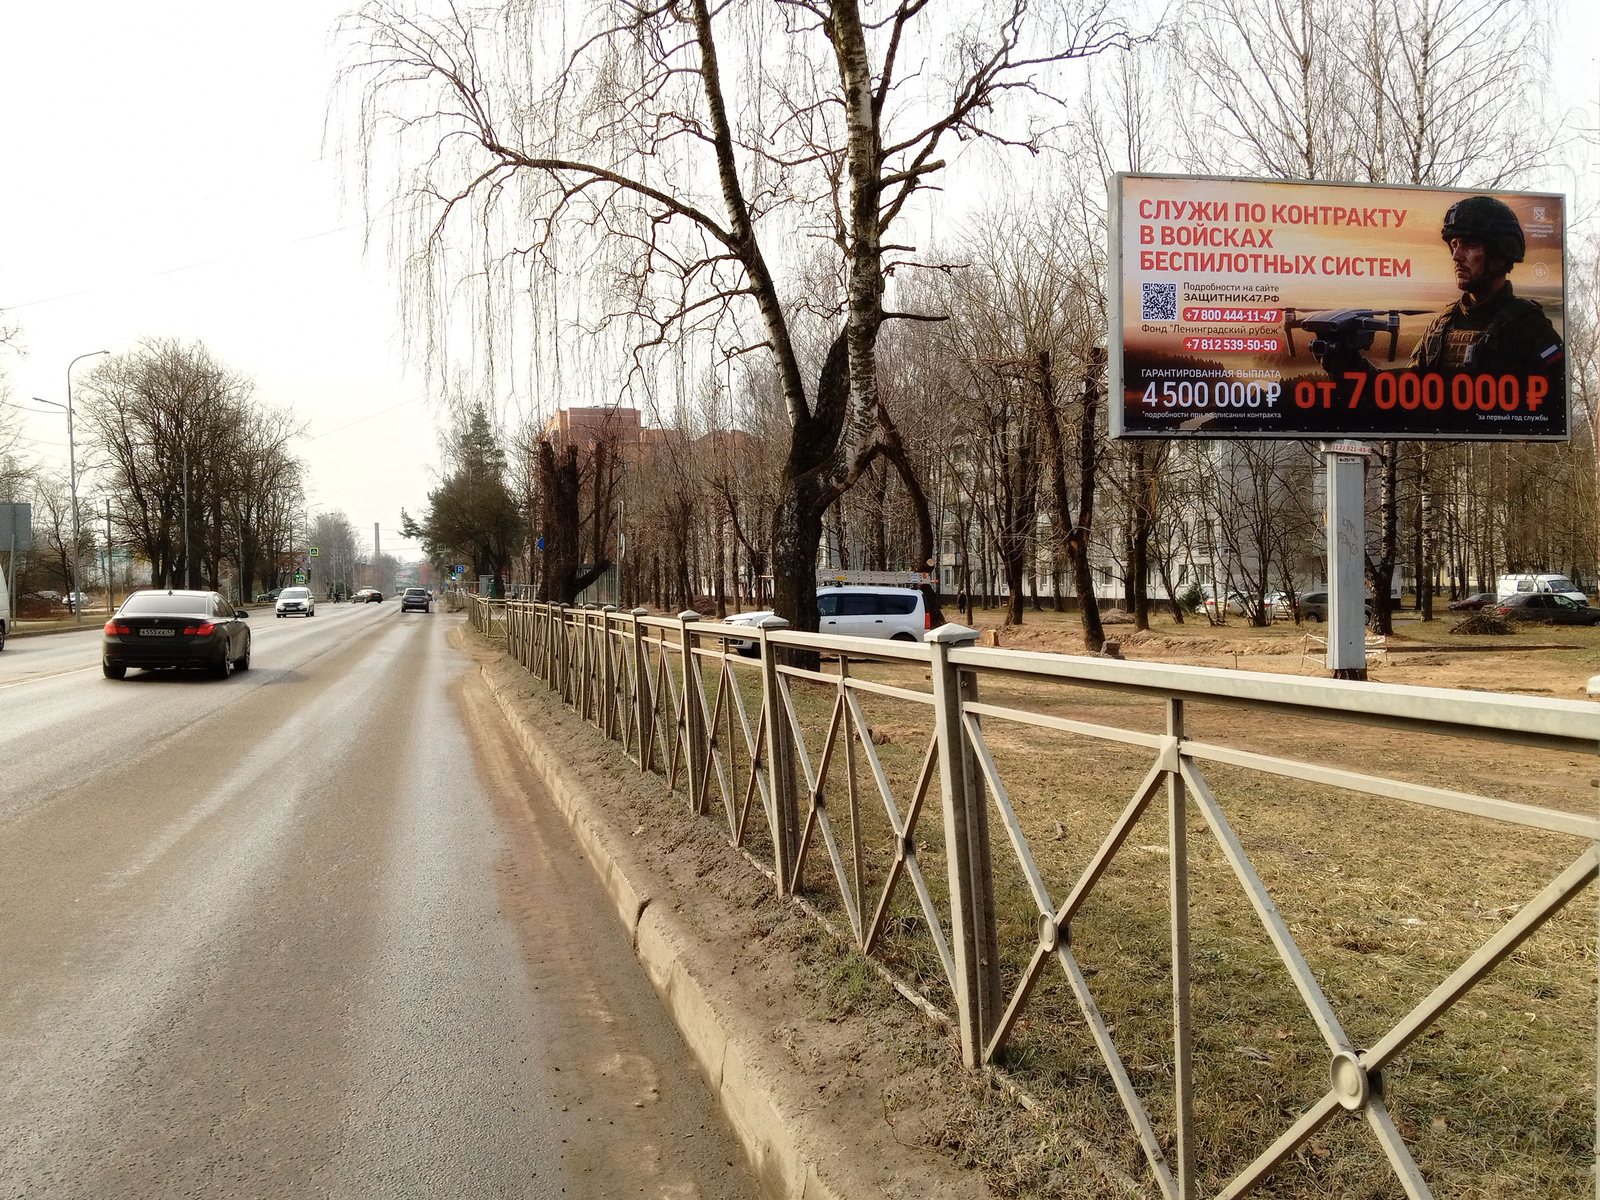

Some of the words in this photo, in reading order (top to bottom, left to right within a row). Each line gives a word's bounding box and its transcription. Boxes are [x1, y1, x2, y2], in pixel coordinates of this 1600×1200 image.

[1140, 200, 1228, 221] СЛУЖИ
[1235, 203, 1266, 222] ПО
[1272, 204, 1407, 228] КОНТРАКТУ
[1140, 226, 1154, 244] В
[1161, 223, 1273, 248] ВОЙСКАХ
[1140, 251, 1316, 274] БЕСПИЛОТНЫХ
[1322, 256, 1411, 278] СИСТЕМ
[1534, 268, 1546, 276] 18+
[1184, 282, 1240, 292] Подробности
[1256, 284, 1279, 292] сайте
[1184, 293, 1280, 302] ЗАЩИТНИК47.РФ
[1186, 310, 1200, 320] +7
[1201, 310, 1221, 320] 800
[1224, 310, 1277, 322] 444-11-47
[1142, 324, 1168, 334] Фонд
[1170, 324, 1246, 334] "Ленинградский
[1248, 326, 1282, 336] рубеж"
[1186, 339, 1200, 350] +7
[1202, 340, 1221, 350] 812
[1224, 340, 1278, 350] 539-50-50
[1141, 368, 1234, 378] ГАРАНТИРОВАННАЯ
[1236, 370, 1282, 378] ВЫПЛАТА
[1142, 382, 1158, 407] 4
[1163, 382, 1208, 407] 500
[1214, 382, 1260, 408] 000
[1344, 372, 1367, 408] 7
[1374, 372, 1444, 410] 000
[1452, 374, 1520, 411] 000
[1486, 414, 1510, 422] первый
[1524, 414, 1548, 422] службы
